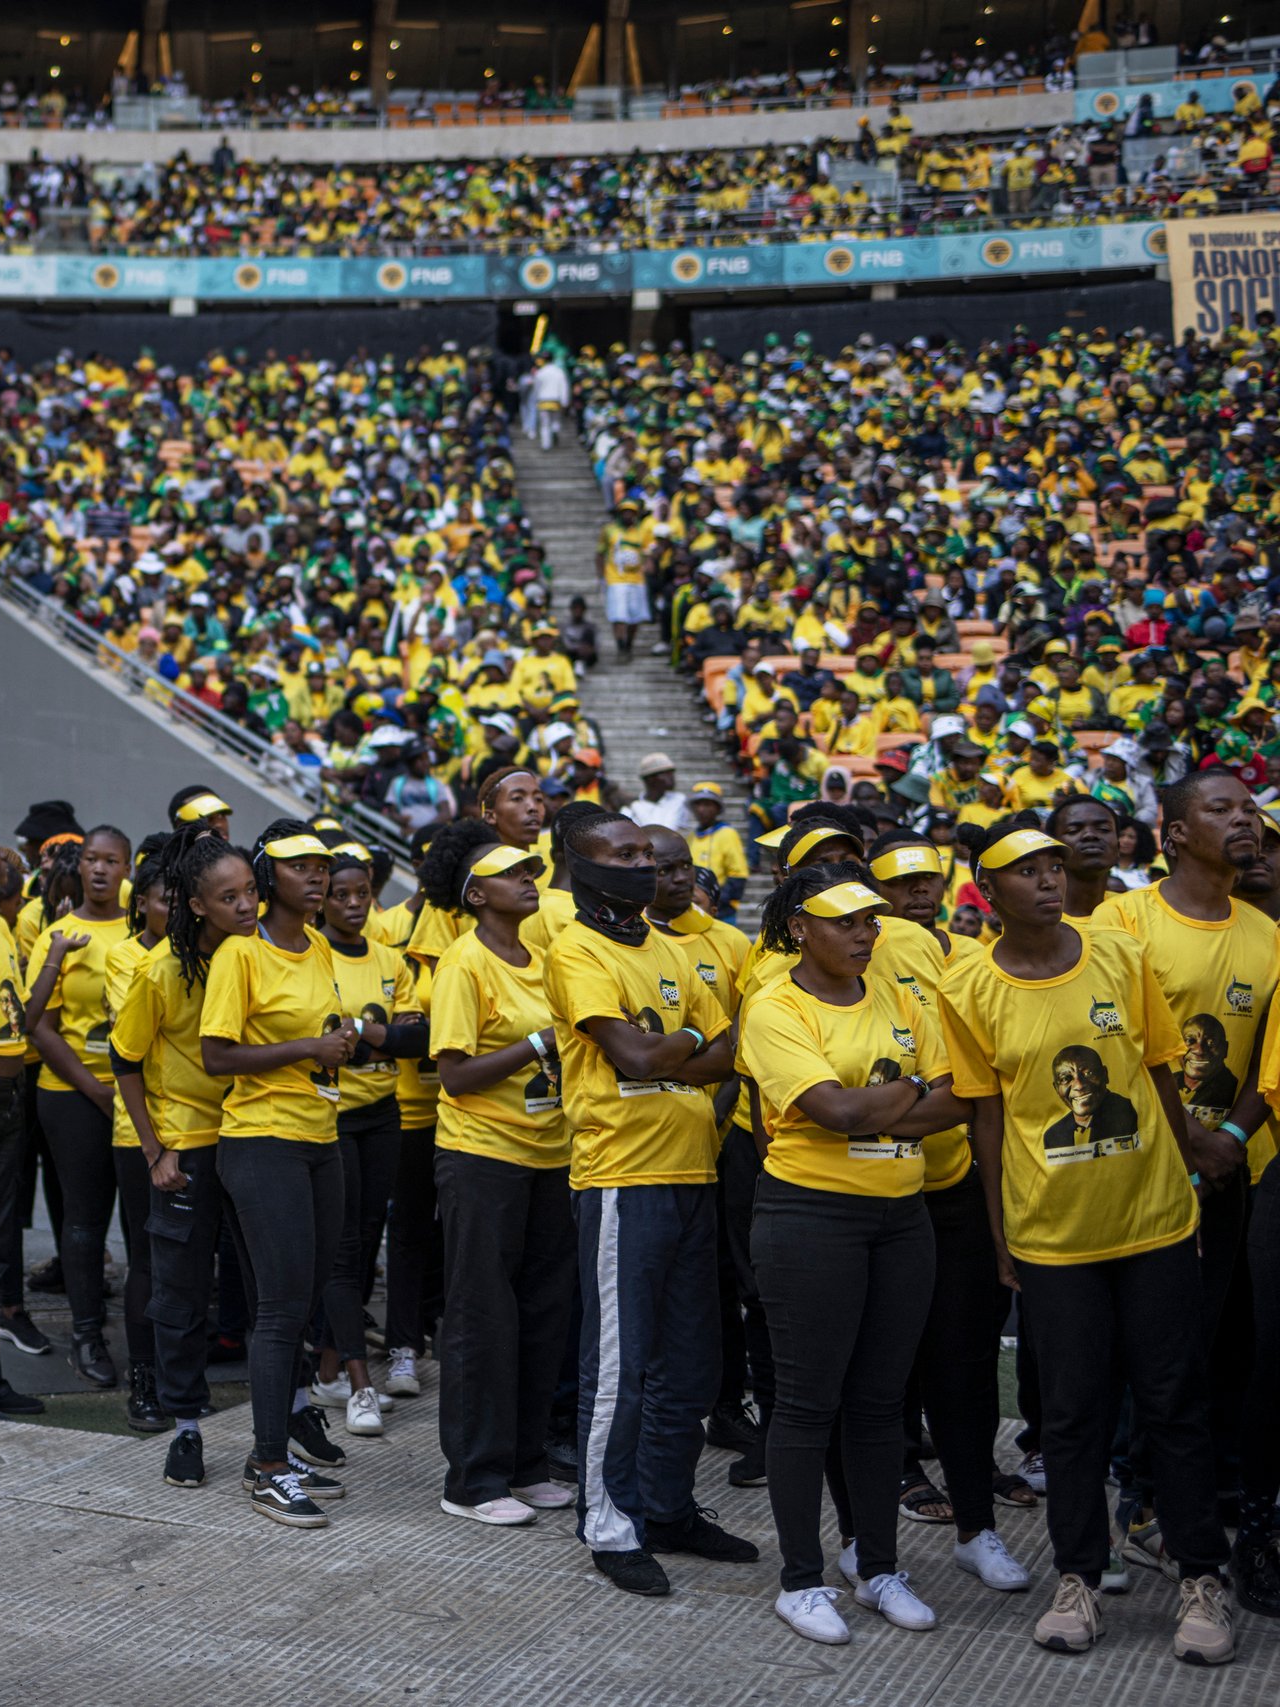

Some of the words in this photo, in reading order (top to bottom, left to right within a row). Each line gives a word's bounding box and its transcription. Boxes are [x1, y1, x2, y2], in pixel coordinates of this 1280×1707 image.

[1020, 240, 1064, 258] FNB
[707, 256, 750, 276] FNB
[860, 249, 904, 268] FNB
[125, 268, 166, 286] FNB
[267, 268, 308, 286] FNB
[411, 267, 452, 286] FNB
[558, 262, 600, 282] FNB
[1108, 1023, 1123, 1032] ANC
